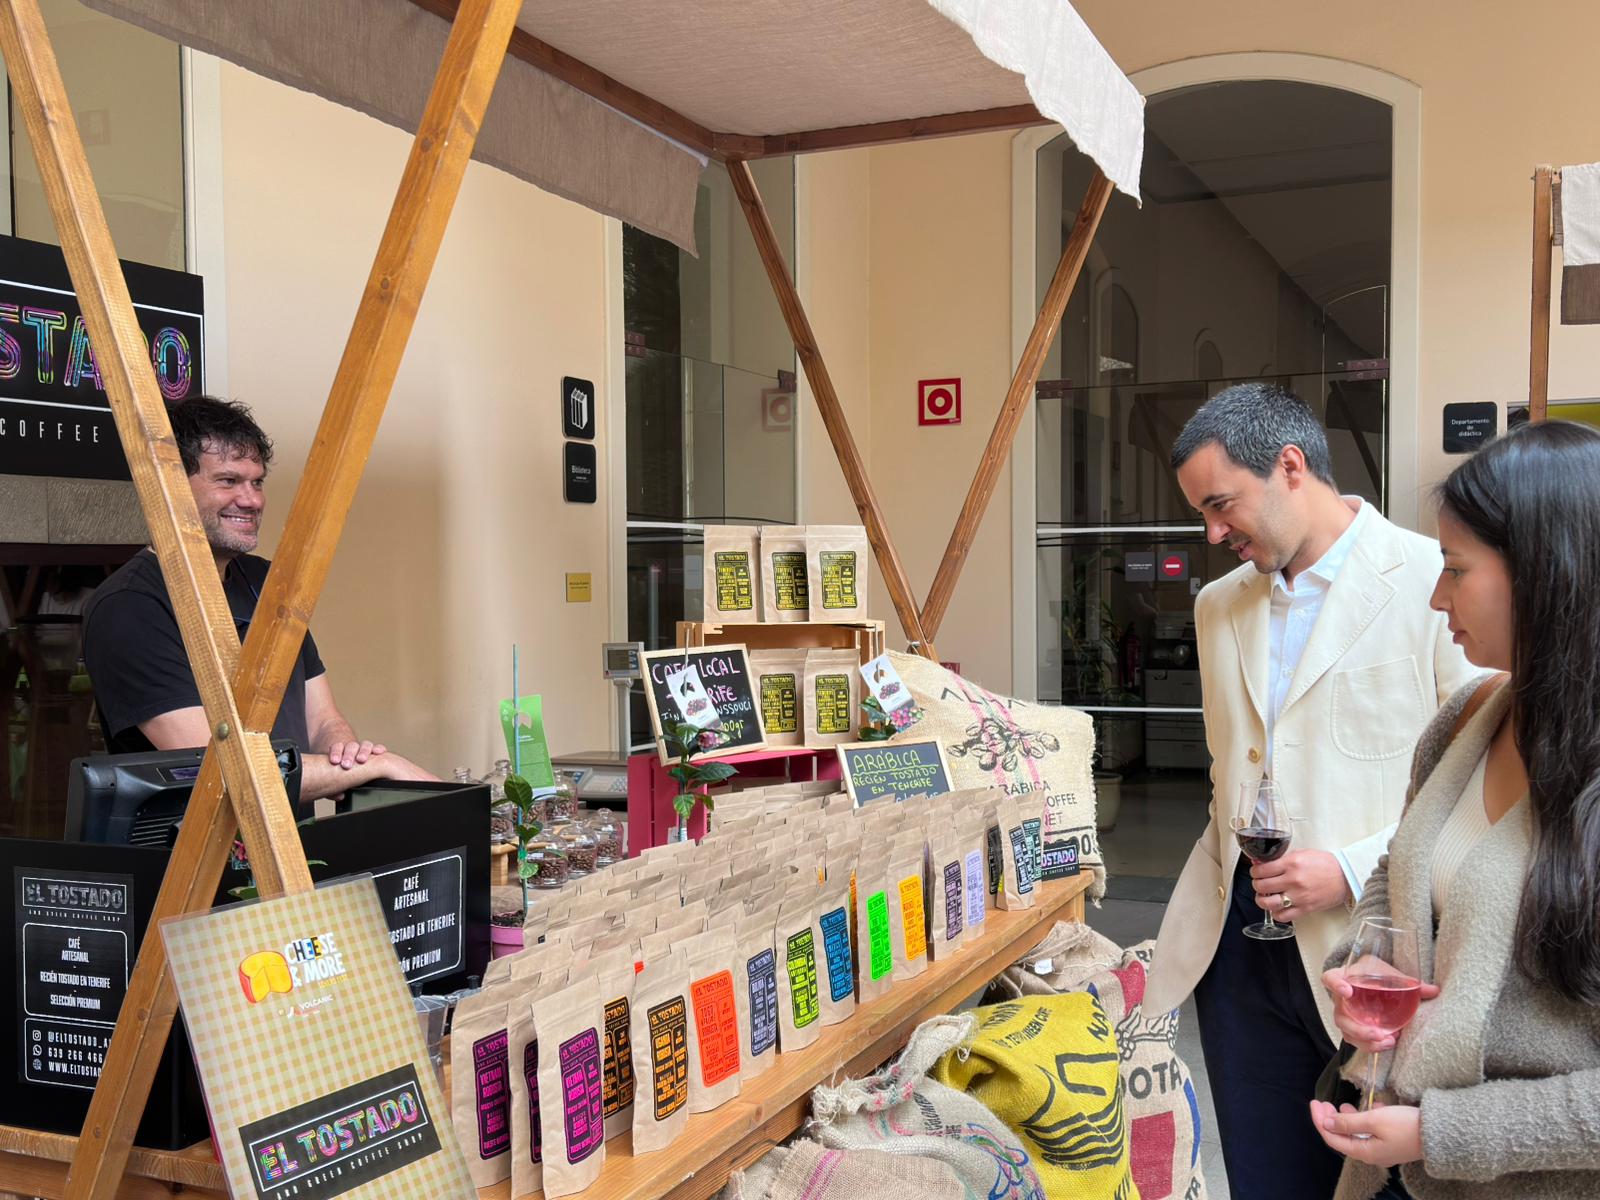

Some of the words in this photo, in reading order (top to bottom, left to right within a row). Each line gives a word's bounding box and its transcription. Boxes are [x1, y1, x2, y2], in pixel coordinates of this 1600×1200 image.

[0, 418, 99, 443] COFFEE
[890, 767, 937, 781] TOSTADO
[871, 785, 885, 794] EN
[1047, 793, 1077, 808] OFFEE
[1042, 849, 1075, 867] OSTADO
[403, 872, 419, 892] CAFÉ
[48, 885, 123, 909] TOSTADO
[394, 889, 429, 911] ARTESANAL
[417, 921, 425, 936] EN
[427, 912, 455, 933] TENERIFE
[68, 936, 81, 949] CAFÉ
[284, 932, 338, 965] CHEESE
[61, 950, 90, 963] ARTESANAL
[412, 948, 441, 970] PREMIUM
[302, 953, 346, 984] MORE
[40, 970, 58, 983] RECIÉN
[58, 973, 80, 986] TOSTADO
[80, 975, 88, 987] EN
[88, 976, 111, 989] TENERIFE
[50, 993, 76, 1007] SELECCIÓN
[76, 998, 101, 1010] PREMIUM
[68, 1049, 82, 1061] 266
[88, 1051, 102, 1064] 466
[259, 1142, 299, 1181] EL
[296, 1091, 418, 1163] TOSTADO
[350, 1146, 390, 1170] COFFEE
[397, 1132, 423, 1150] SHOP
